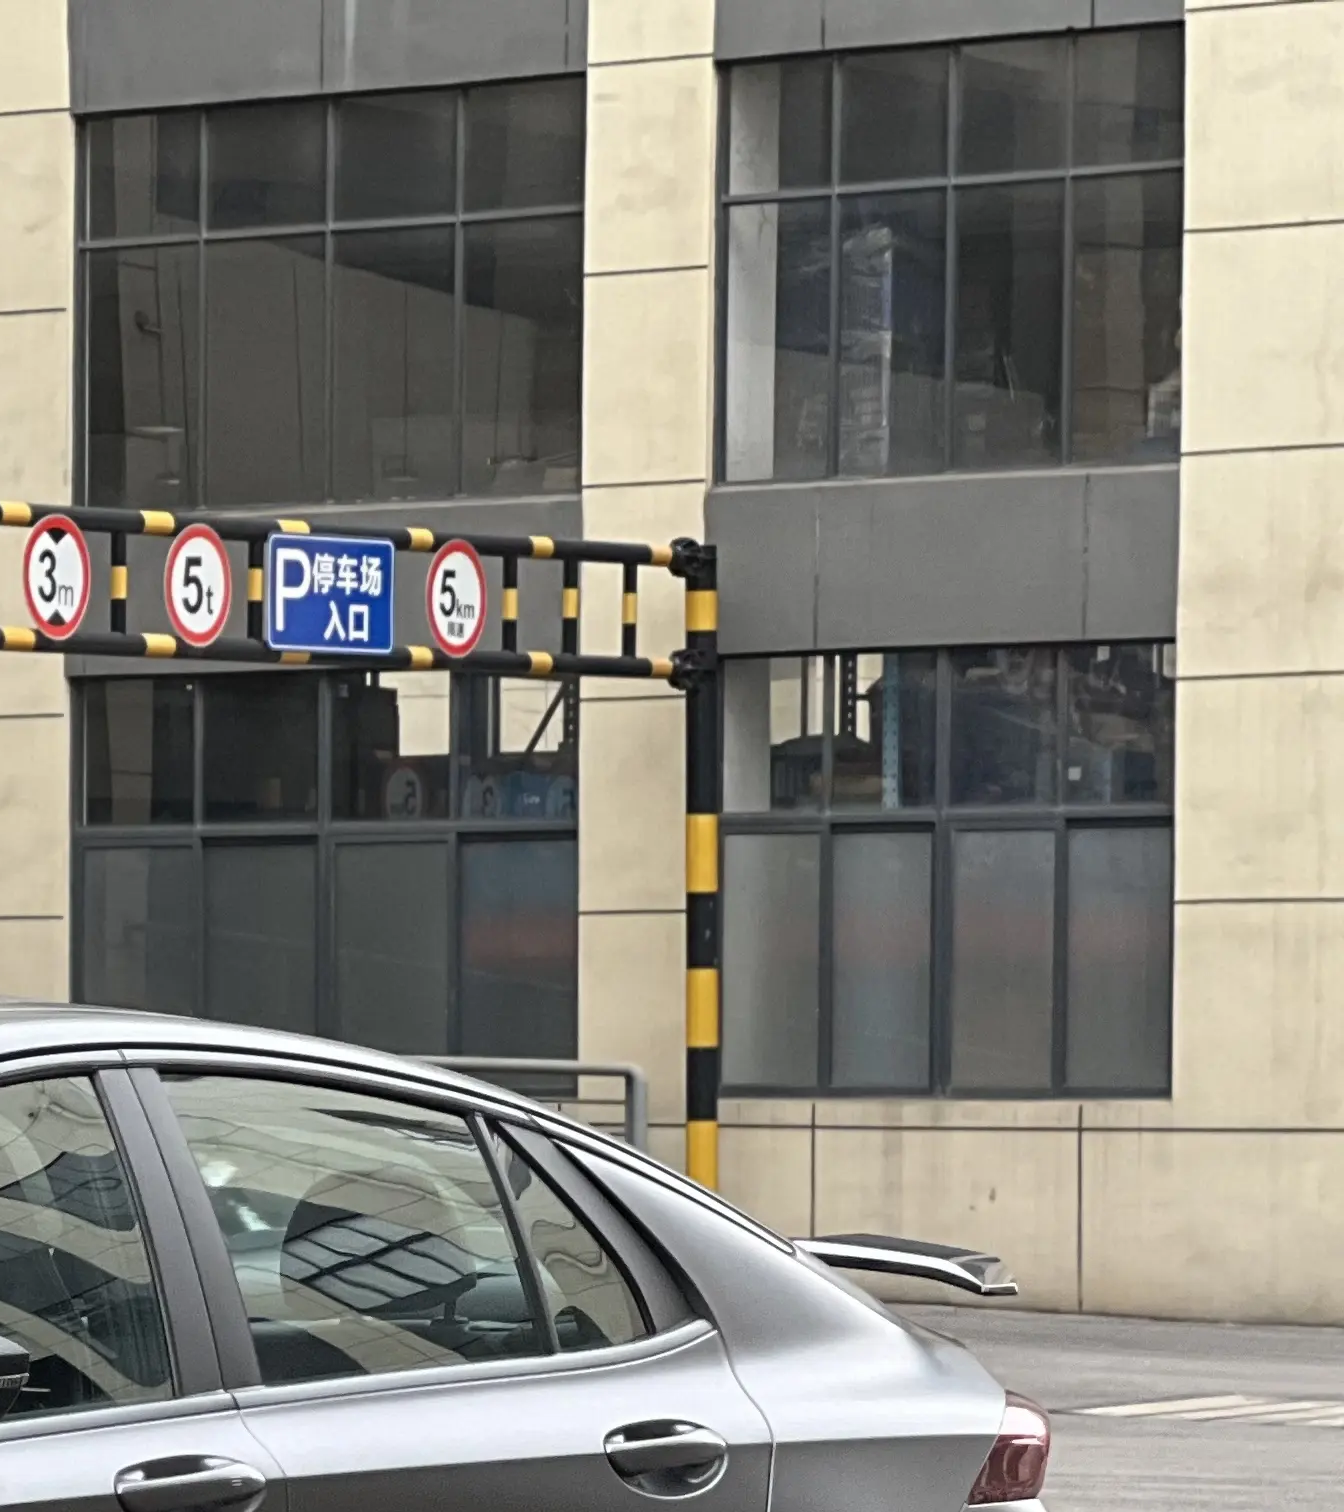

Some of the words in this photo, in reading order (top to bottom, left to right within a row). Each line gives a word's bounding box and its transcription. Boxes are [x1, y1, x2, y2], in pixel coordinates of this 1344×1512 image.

[275, 547, 311, 632] P
[312, 552, 382, 597] 停车场
[323, 601, 369, 643] 入口
